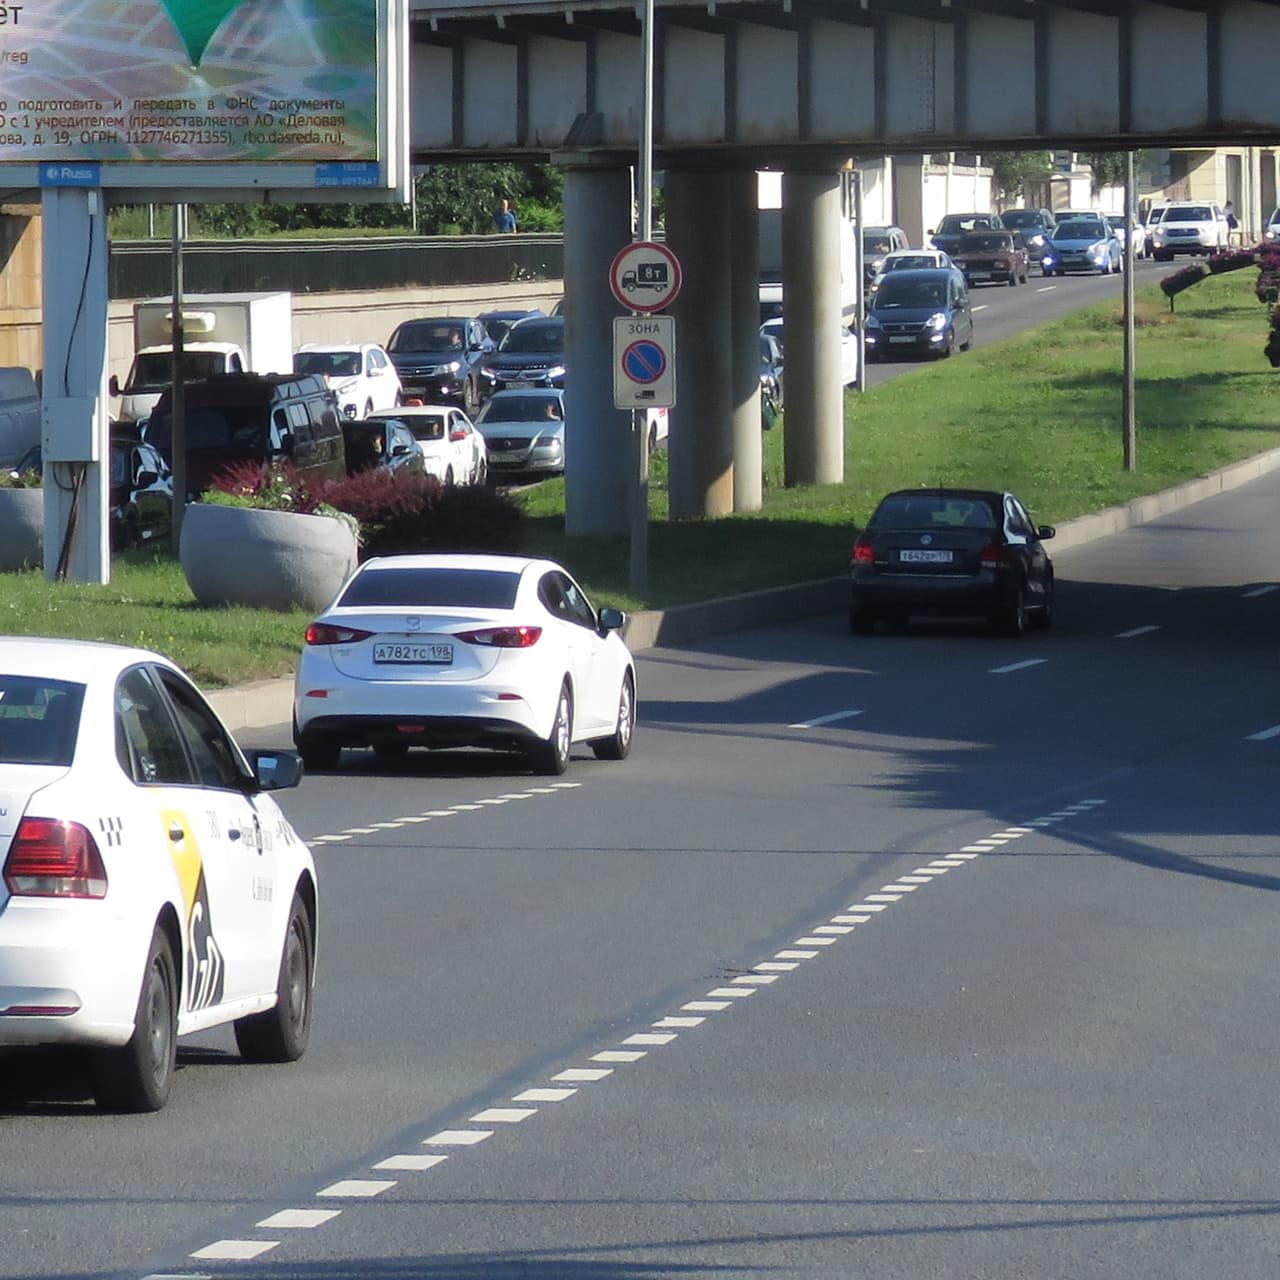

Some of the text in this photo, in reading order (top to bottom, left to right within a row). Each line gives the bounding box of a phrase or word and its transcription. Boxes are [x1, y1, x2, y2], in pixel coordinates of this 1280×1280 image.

[18, 99, 103, 114] подготовить
[113, 100, 122, 110] и
[133, 99, 197, 113] передать
[226, 97, 257, 110] ФНС
[268, 99, 345, 114] документы
[34, 116, 124, 132] учредителем
[128, 114, 249, 131] (предоставляется
[254, 114, 274, 127] АО
[32, 134, 46, 147] д.
[54, 131, 73, 147] 19,
[80, 130, 118, 144] ОГРН
[61, 167, 93, 179] Russ
[628, 323, 660, 335] ЗОНА
[378, 646, 427, 659] А782ТС
